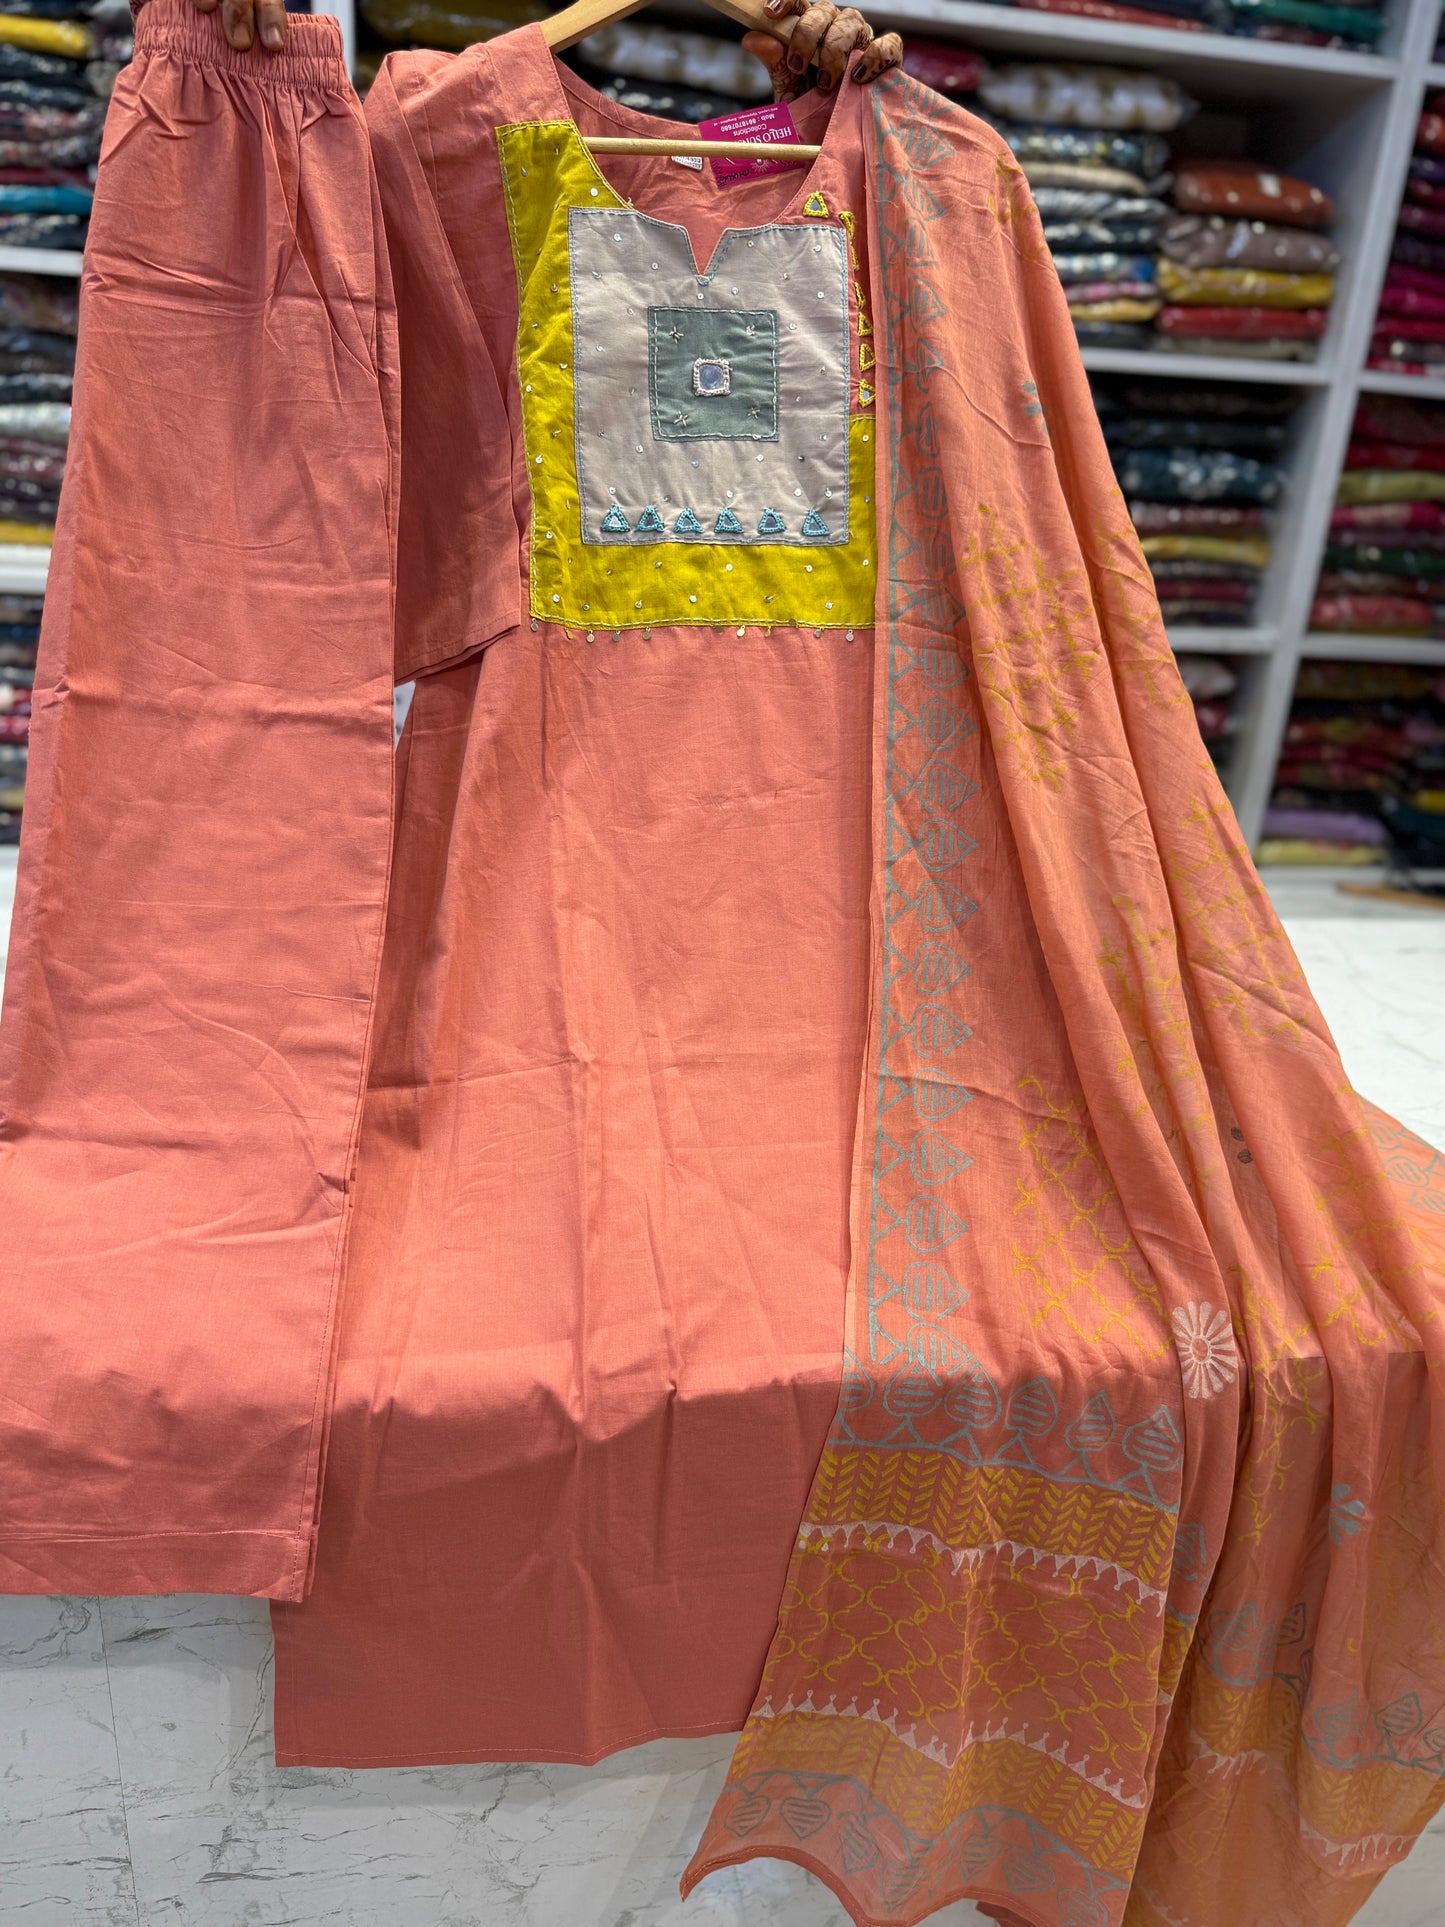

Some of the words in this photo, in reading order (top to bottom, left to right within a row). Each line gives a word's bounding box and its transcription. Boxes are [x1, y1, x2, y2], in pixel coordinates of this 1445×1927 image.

[760, 113, 775, 121] Mob
[733, 123, 767, 137] Collections
[762, 126, 792, 143] HELLO
